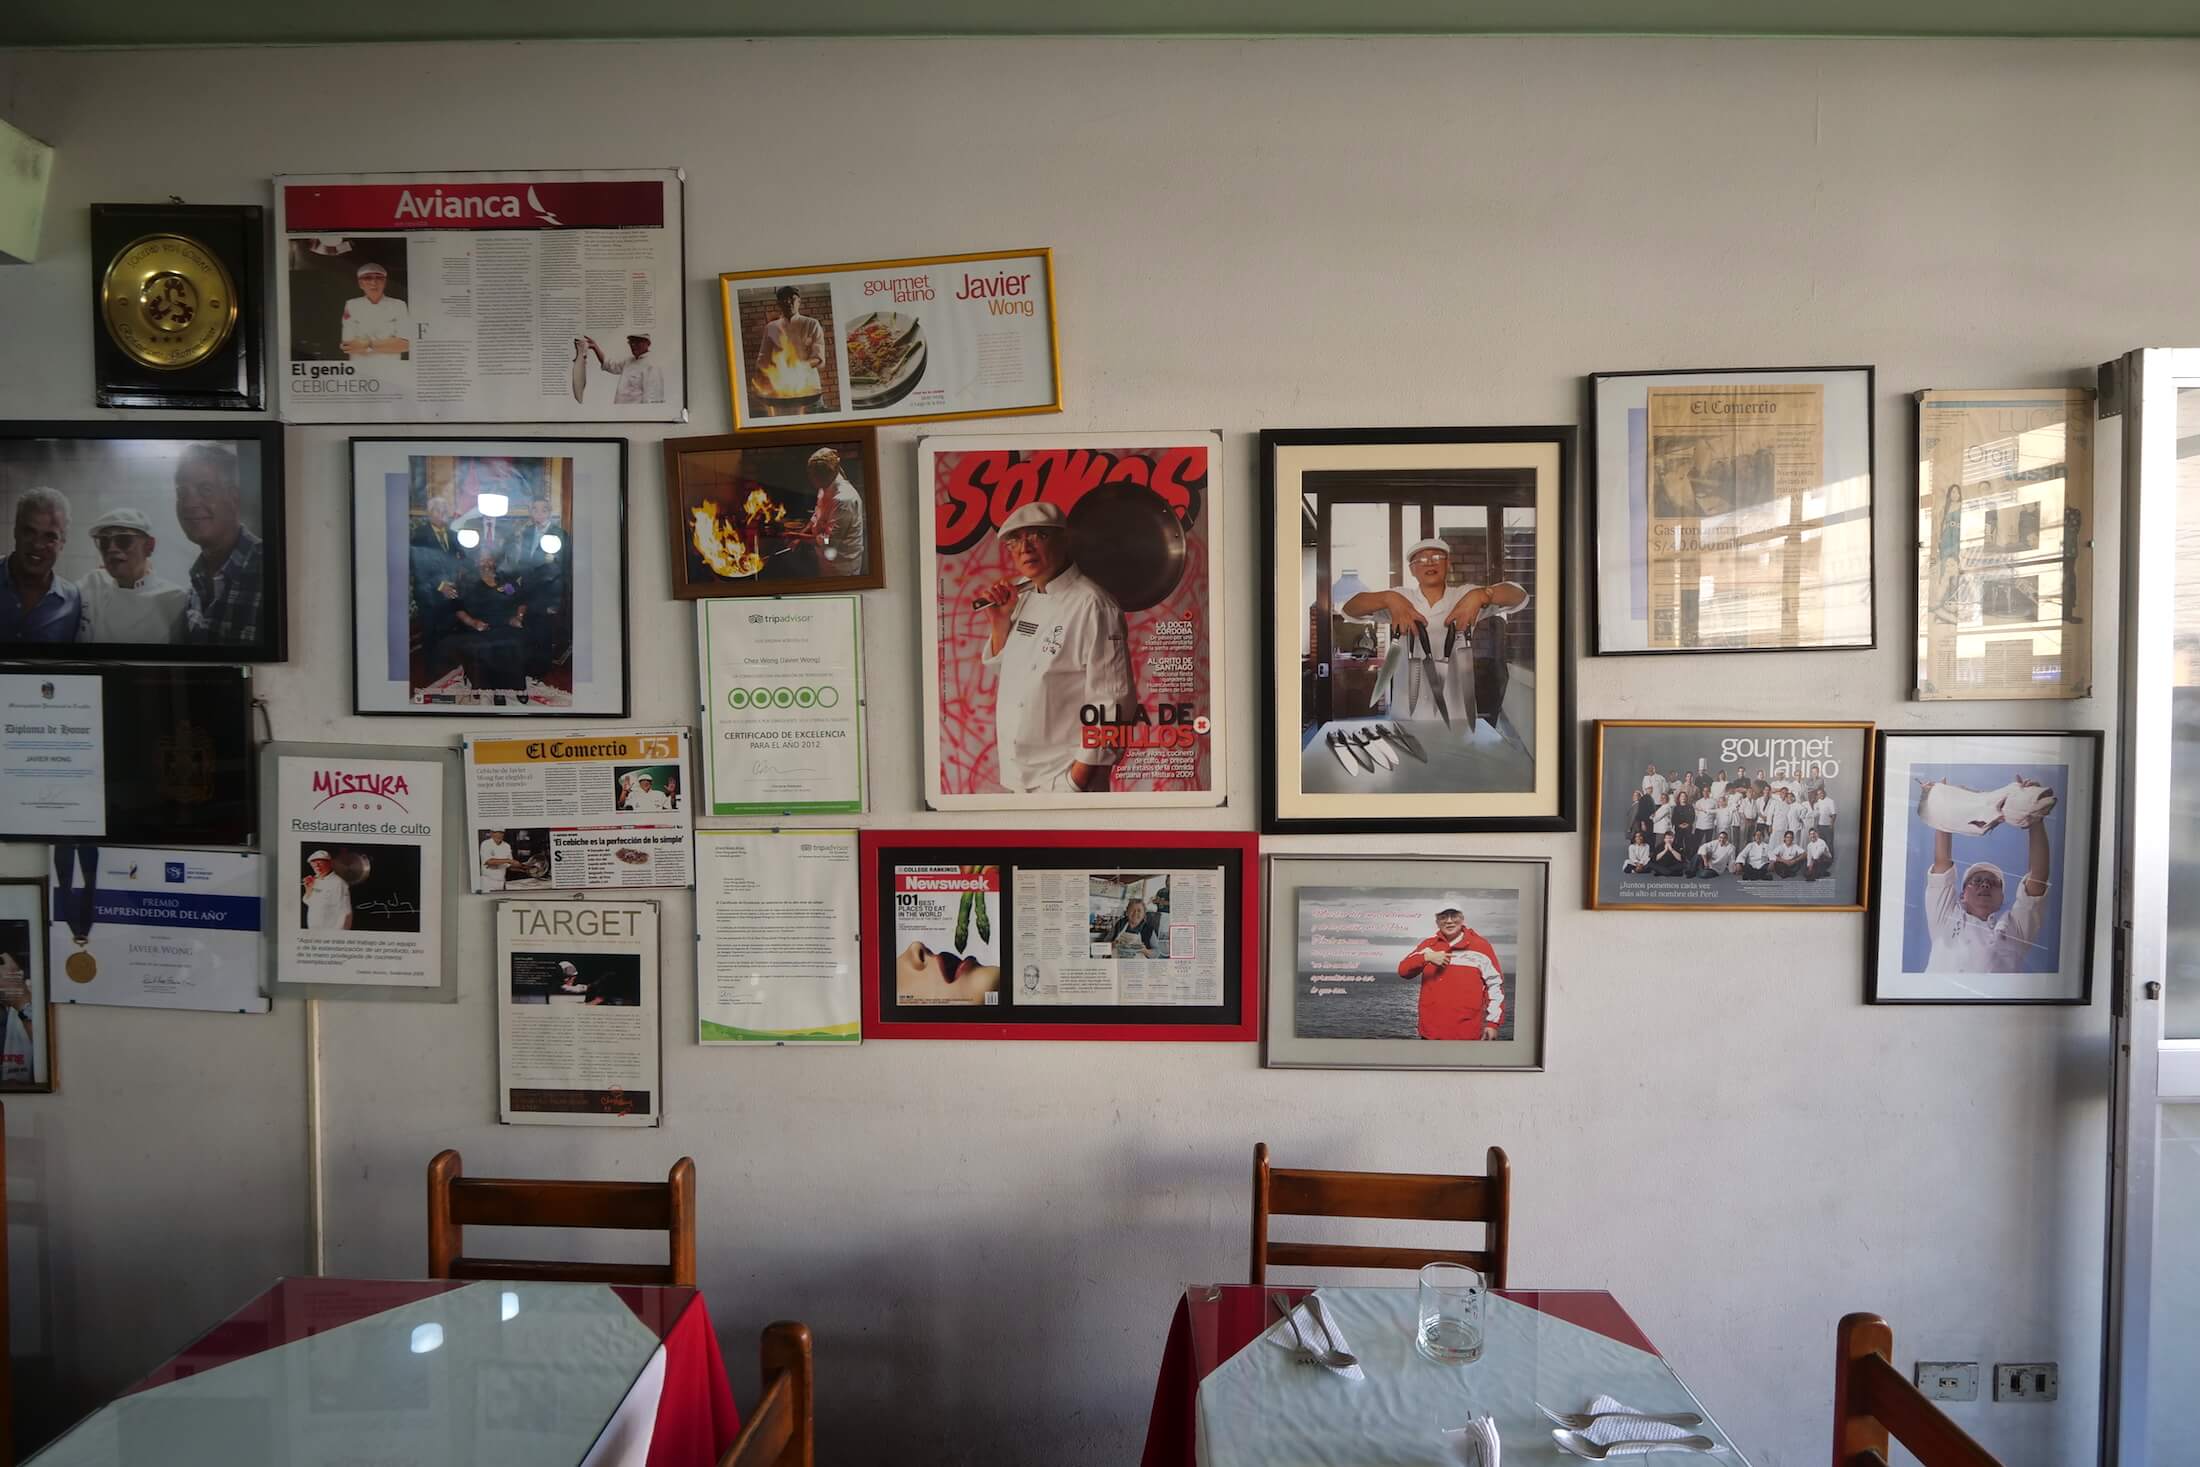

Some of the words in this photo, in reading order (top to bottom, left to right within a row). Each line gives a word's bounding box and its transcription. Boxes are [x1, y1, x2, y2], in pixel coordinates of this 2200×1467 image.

[395, 189, 520, 219] Avianca
[864, 274, 929, 297] gourmet
[956, 271, 1031, 300] Javier
[893, 289, 936, 303] latino
[988, 299, 1034, 317] Wong
[291, 363, 306, 376] El
[311, 363, 355, 378] genio
[291, 379, 380, 393] CEBICHERO
[1690, 400, 1708, 415] El
[1711, 400, 1777, 415] Comercio
[765, 614, 811, 625] tripadvisor
[1155, 621, 1166, 629] LA
[1147, 657, 1158, 665] AL
[1159, 657, 1181, 665] GRITO
[1183, 656, 1193, 664] DE
[1080, 703, 1152, 726] OLLA
[1158, 703, 1194, 726] DE
[5, 724, 45, 735] Diploma
[48, 724, 57, 734] de
[61, 724, 91, 735] Honor
[724, 731, 779, 740] CERTIFICADO
[781, 731, 793, 739] DE
[795, 730, 846, 739] EXCELENCIA
[1082, 725, 1195, 749] BRILLOS
[526, 742, 546, 759] El
[550, 740, 628, 758] Comercio
[750, 741, 770, 749] PARA
[772, 741, 781, 749] EL
[802, 741, 820, 749] 2012
[1720, 736, 1833, 763] gourmet
[1769, 756, 1839, 779] latino
[339, 802, 383, 811] 2009
[292, 819, 377, 833] Restaurantes
[380, 822, 397, 834] de
[400, 823, 431, 835] culto
[563, 837, 589, 846] cebiche
[599, 837, 605, 845] la
[606, 836, 642, 847] perfección
[643, 836, 651, 844] de
[652, 836, 659, 844] lo
[905, 875, 990, 891] Newsweek
[142, 898, 180, 908] PREMIO
[896, 894, 918, 906] 101
[179, 909, 199, 920] DEL
[511, 908, 642, 937] TARGET
